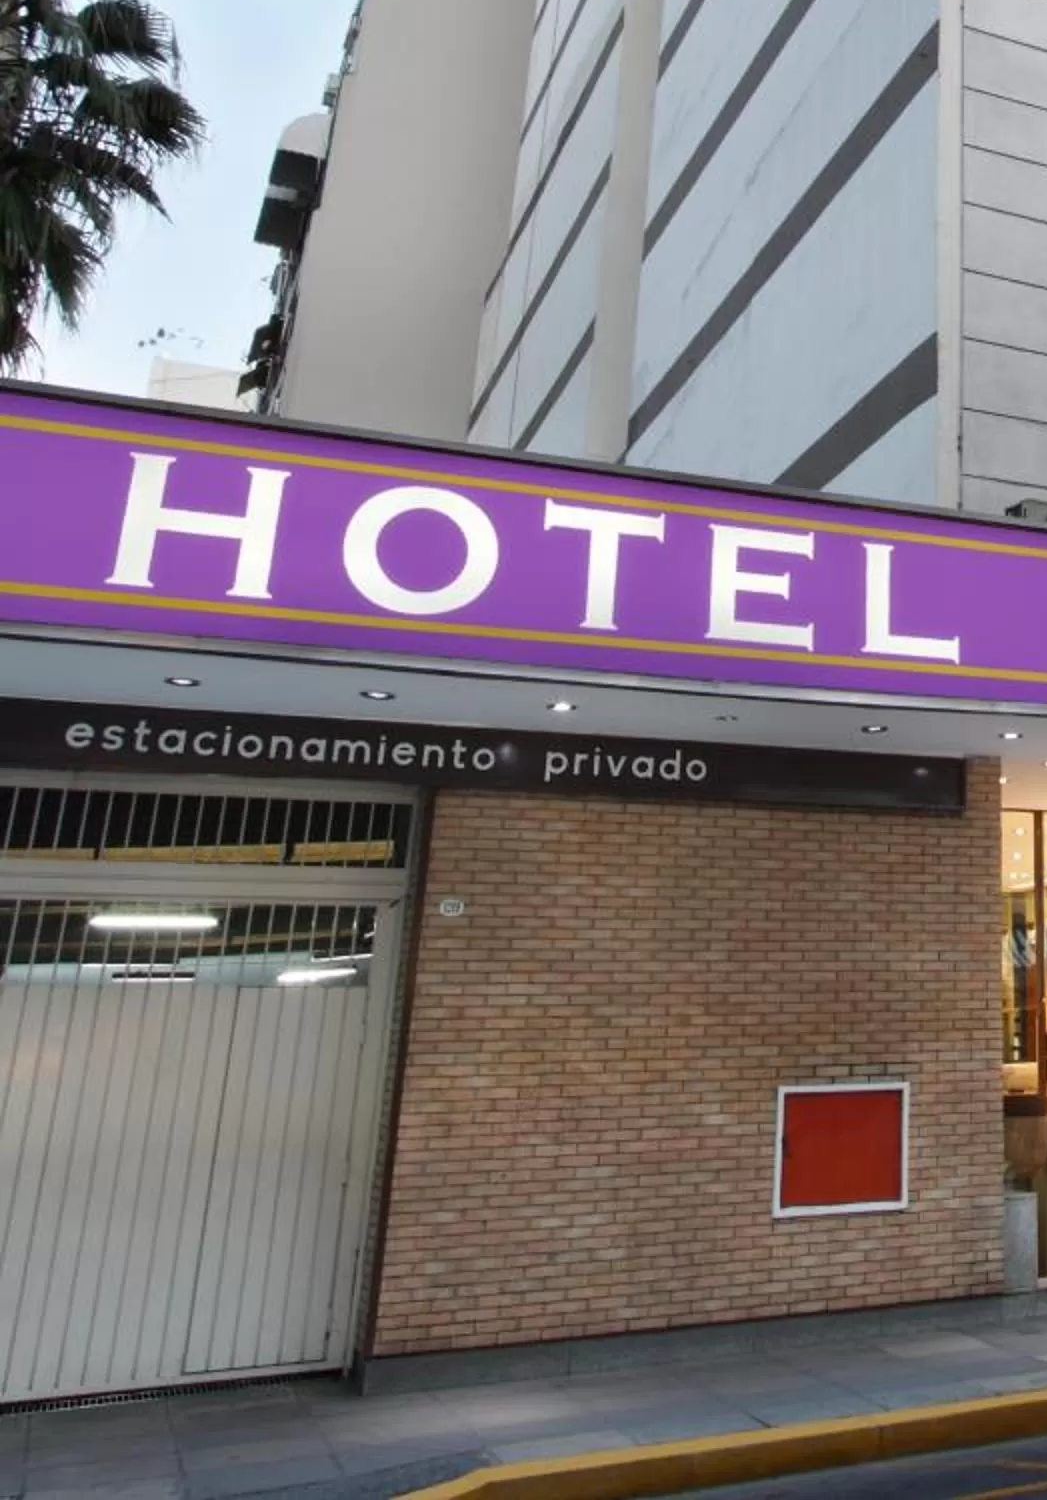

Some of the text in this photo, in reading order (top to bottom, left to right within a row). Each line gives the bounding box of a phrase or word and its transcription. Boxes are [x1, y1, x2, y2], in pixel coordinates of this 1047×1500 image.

[105, 451, 961, 666] HOTEL
[65, 719, 708, 782] estacionamiento privado
